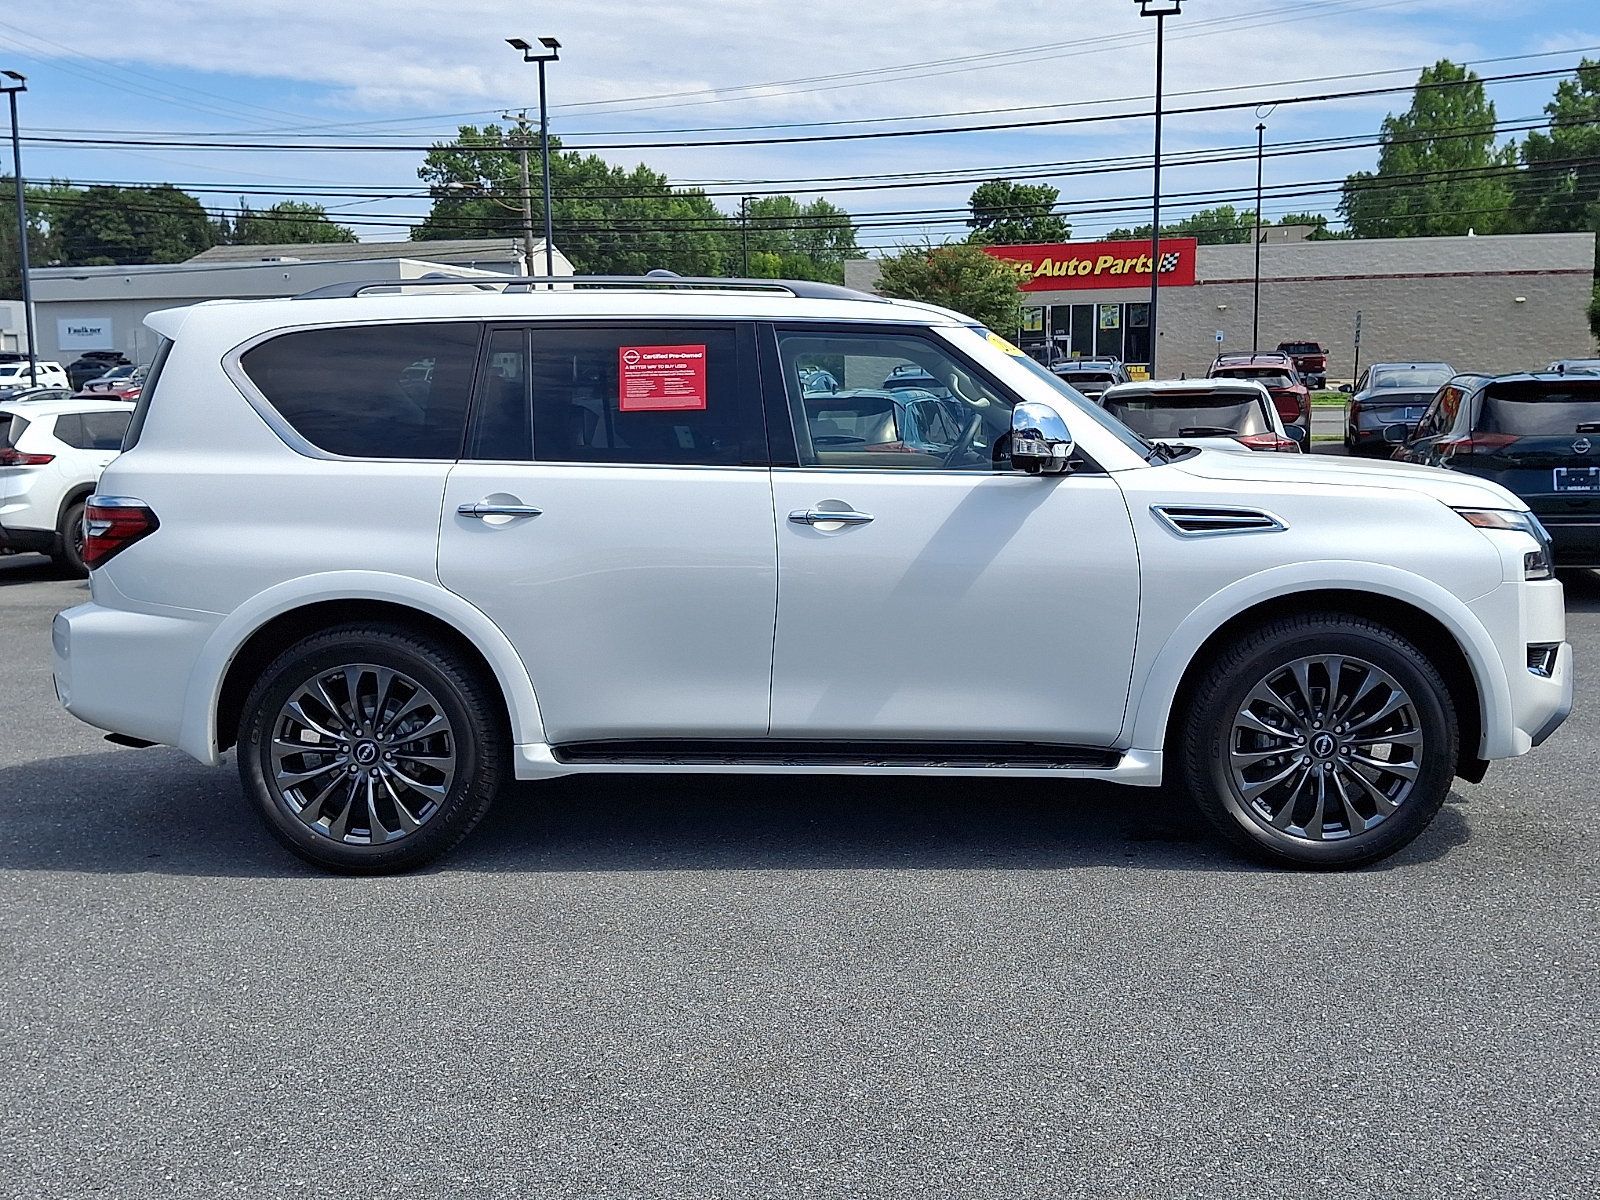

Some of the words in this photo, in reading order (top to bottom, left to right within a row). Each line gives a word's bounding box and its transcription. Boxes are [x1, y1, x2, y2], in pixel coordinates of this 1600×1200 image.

[1034, 257, 1093, 277] Auto
[1094, 254, 1154, 275] Parts
[68, 326, 101, 334] Faulkner
